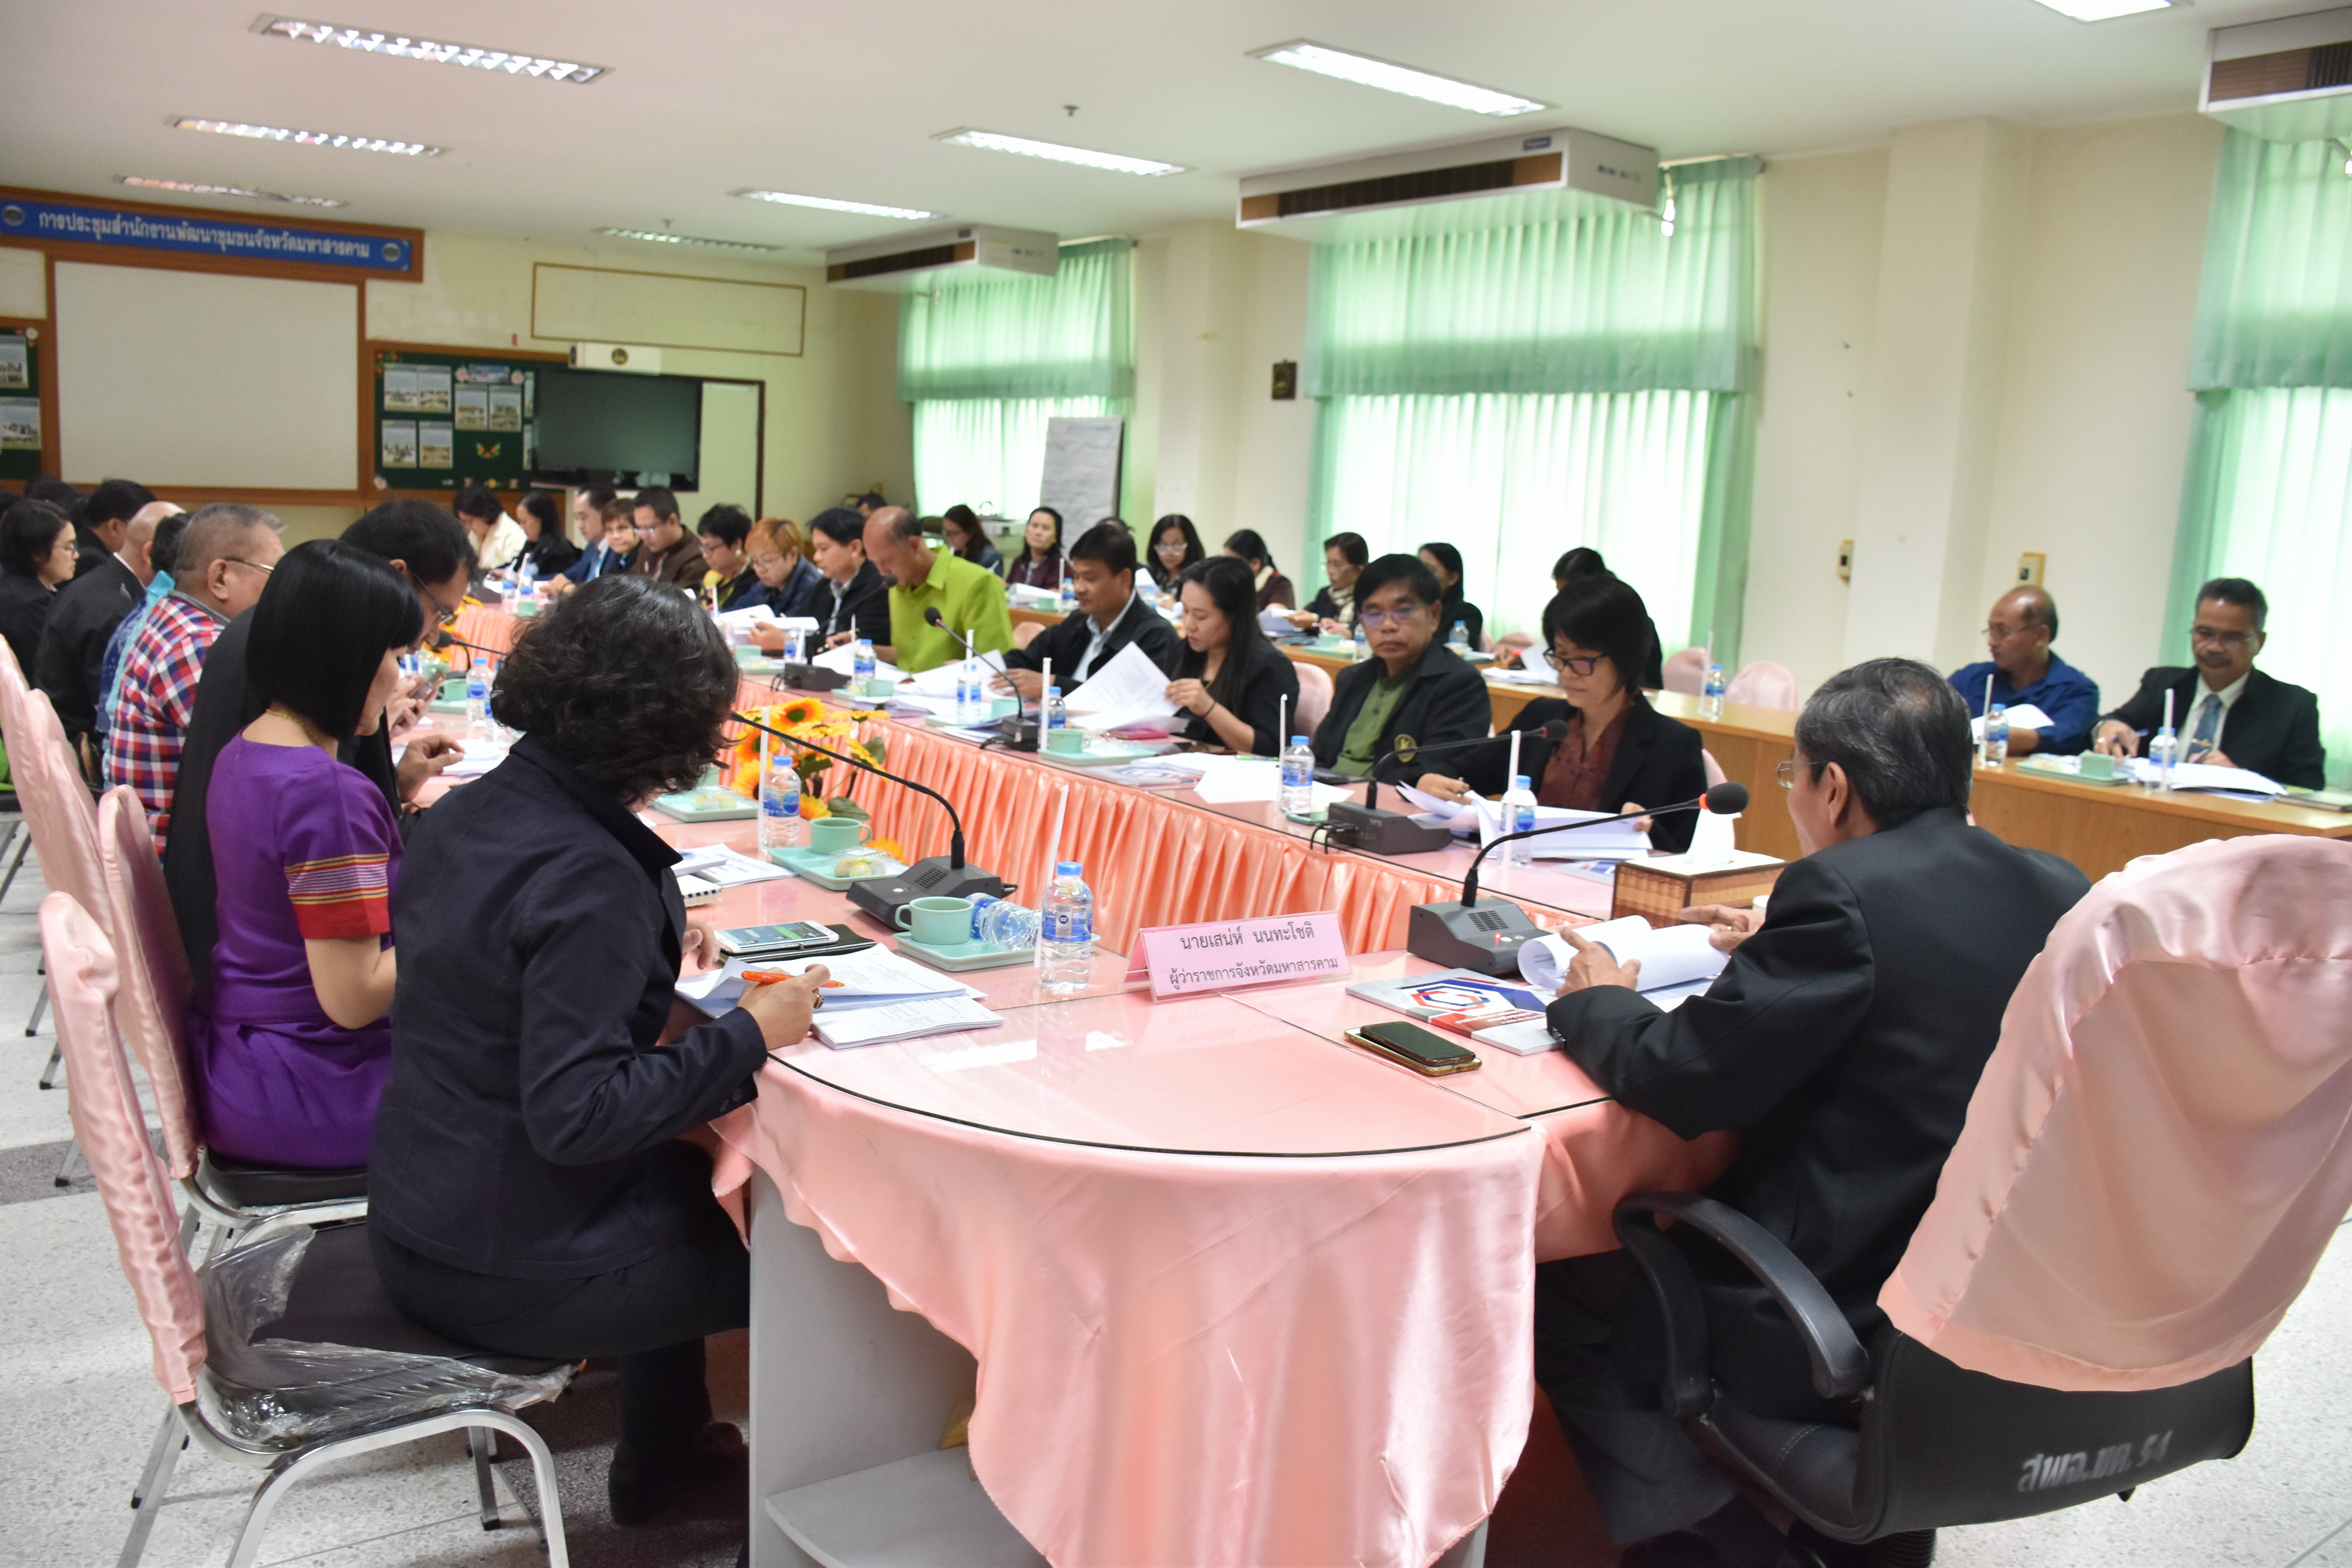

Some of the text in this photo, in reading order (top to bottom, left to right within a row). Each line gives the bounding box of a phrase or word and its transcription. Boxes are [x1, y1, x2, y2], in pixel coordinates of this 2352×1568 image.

[1180, 921, 1315, 950] นายเสน่ห์ นนทะโชติ
[1169, 957, 1338, 990] ผู้ว่าราชการจังหวัดมหาสารคาม
